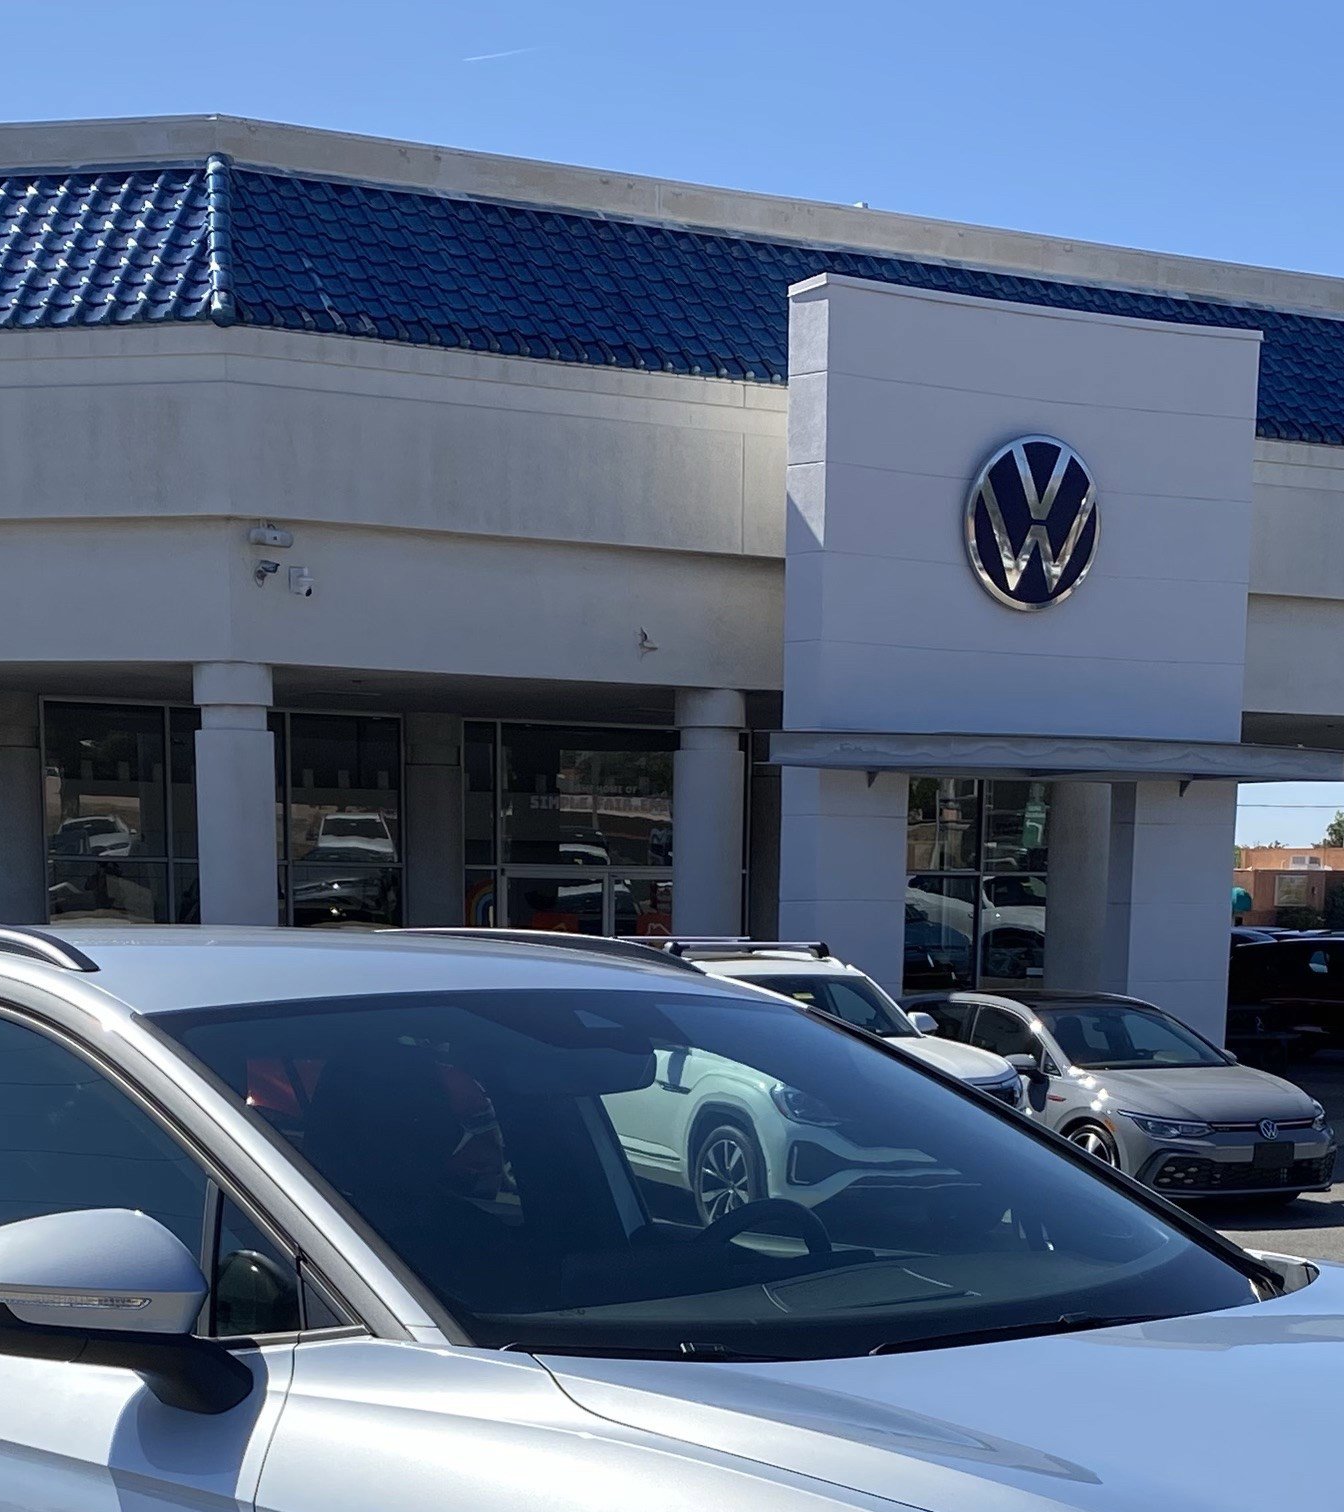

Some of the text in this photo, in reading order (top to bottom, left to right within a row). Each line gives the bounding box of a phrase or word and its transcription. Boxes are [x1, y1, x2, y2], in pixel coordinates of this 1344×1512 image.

[974, 438, 1099, 602] VW
[597, 785, 623, 794] HOME
[625, 785, 638, 794] OF
